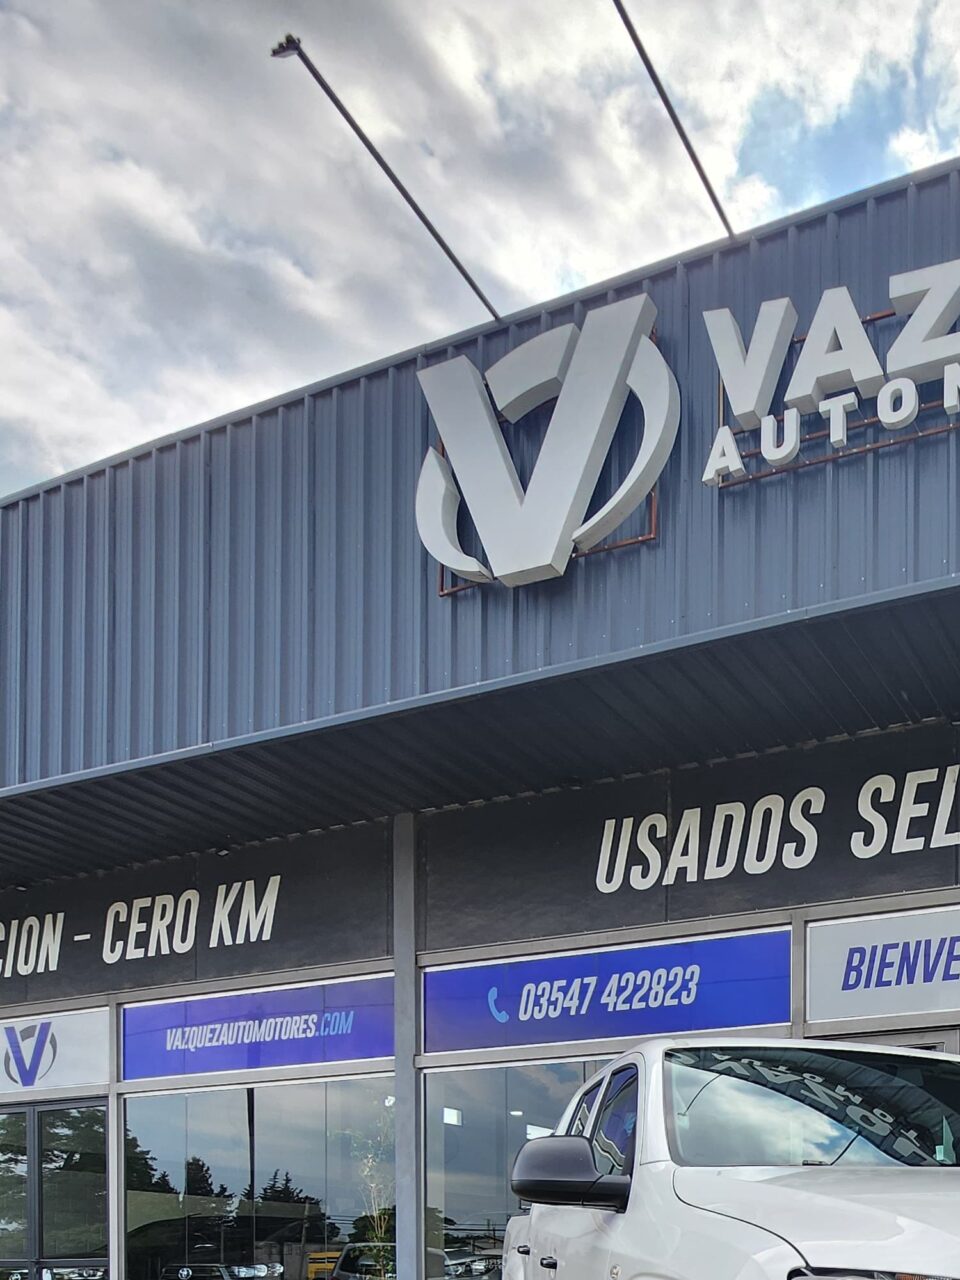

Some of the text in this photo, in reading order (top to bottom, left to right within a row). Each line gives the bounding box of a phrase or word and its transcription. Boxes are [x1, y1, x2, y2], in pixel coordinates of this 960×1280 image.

[595, 787, 825, 893] USADOS
[0, 912, 65, 978] ION
[102, 889, 200, 964] CERO
[208, 875, 281, 947] KM
[166, 1011, 354, 1051] VAZQUEZAUTOMOTORES.COM
[518, 965, 700, 1021] 03547 422823
